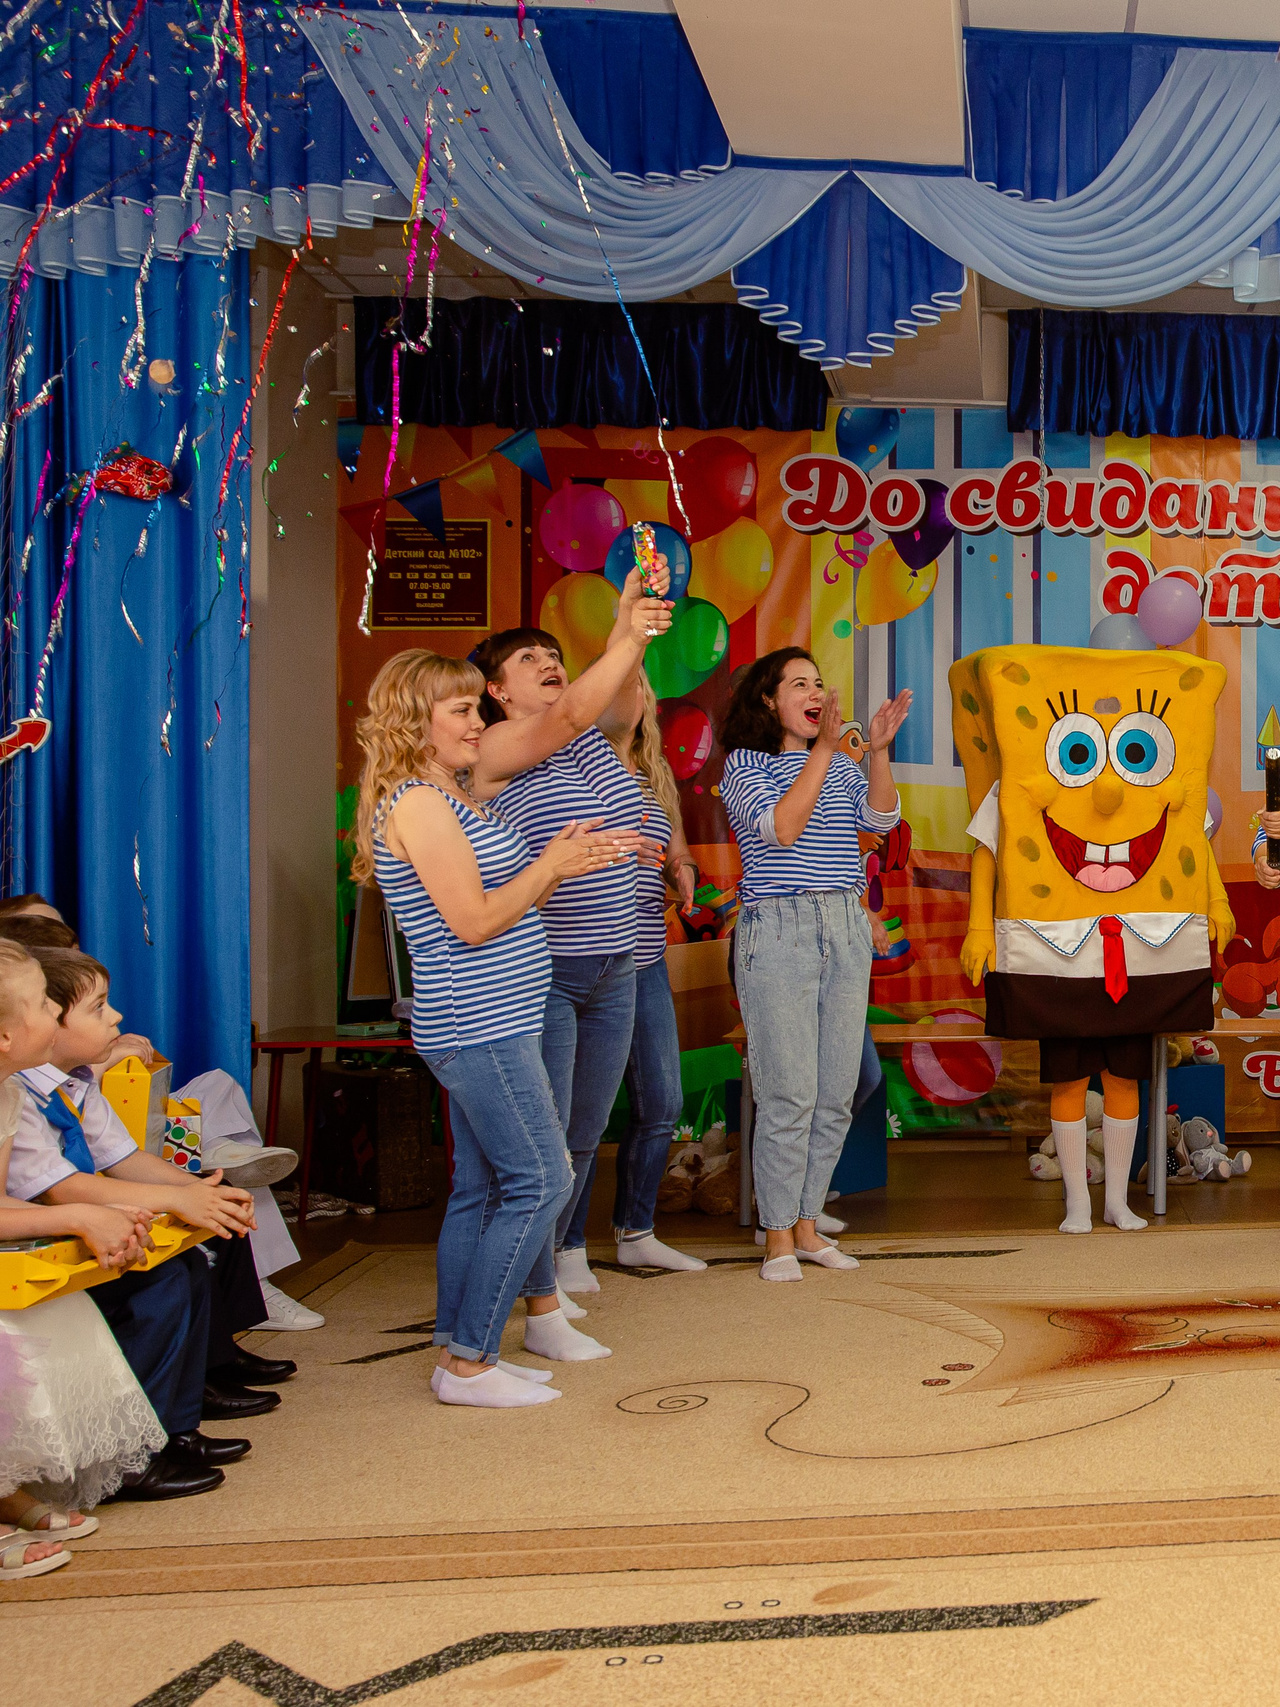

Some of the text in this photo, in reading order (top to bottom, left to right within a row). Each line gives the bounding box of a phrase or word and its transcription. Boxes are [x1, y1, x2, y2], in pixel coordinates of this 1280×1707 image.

[782, 455, 924, 530] До
[385, 549, 483, 559] Детский сад №102»
